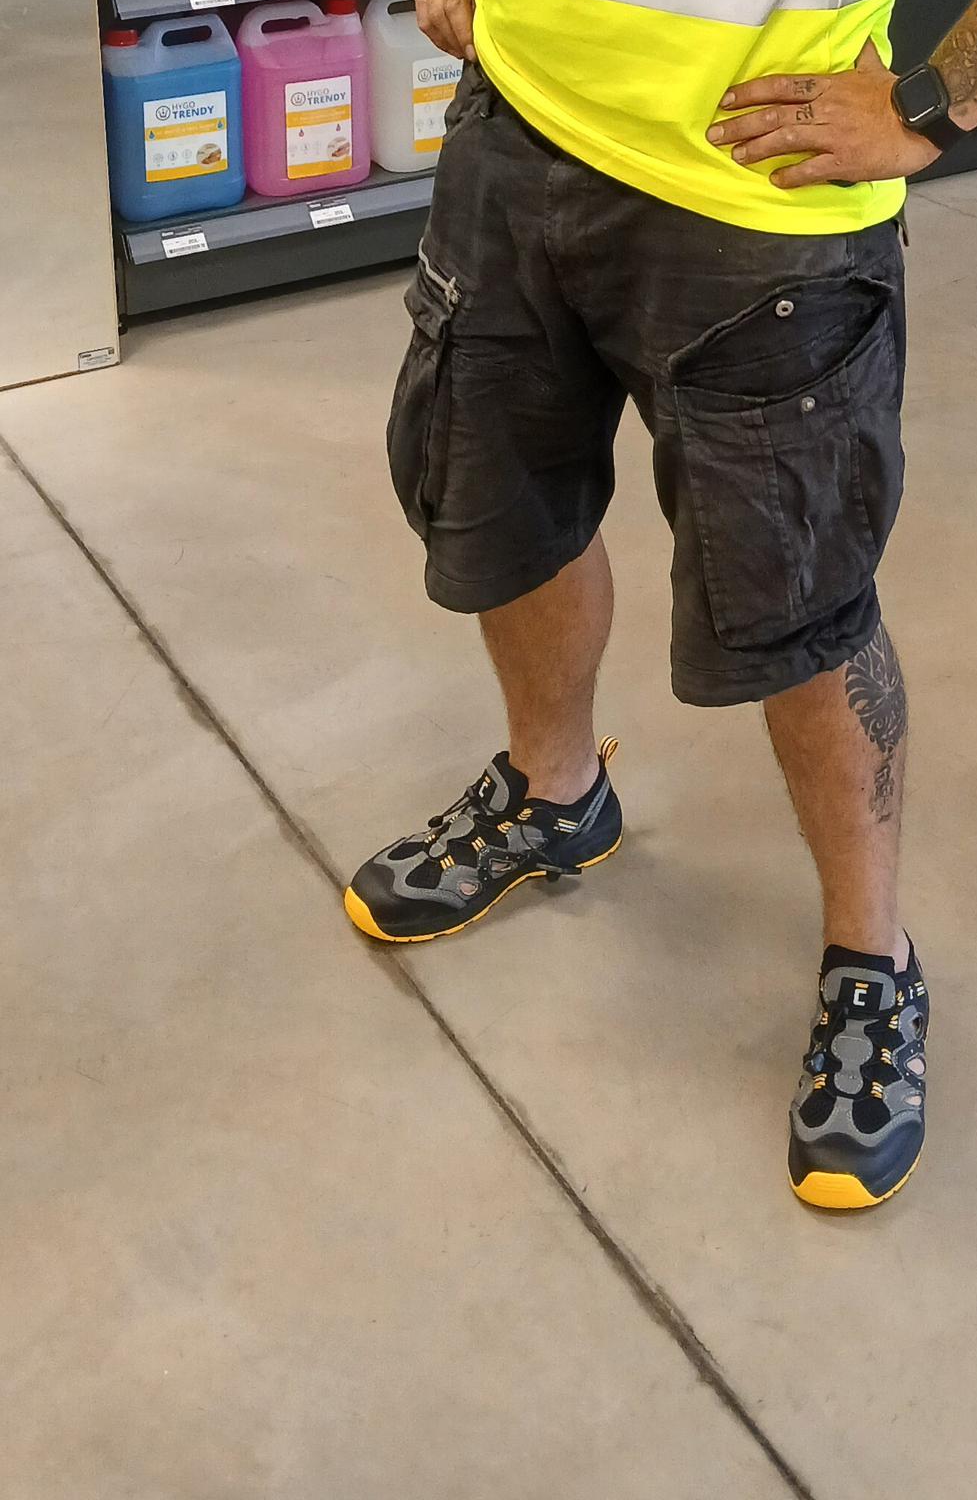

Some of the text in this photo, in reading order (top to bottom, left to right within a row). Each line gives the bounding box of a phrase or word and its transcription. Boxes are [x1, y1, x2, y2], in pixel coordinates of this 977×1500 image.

[433, 69, 462, 81] TREND
[307, 92, 346, 105] TRENDY
[171, 100, 196, 111] HYGO
[172, 105, 214, 119] TRENDY
